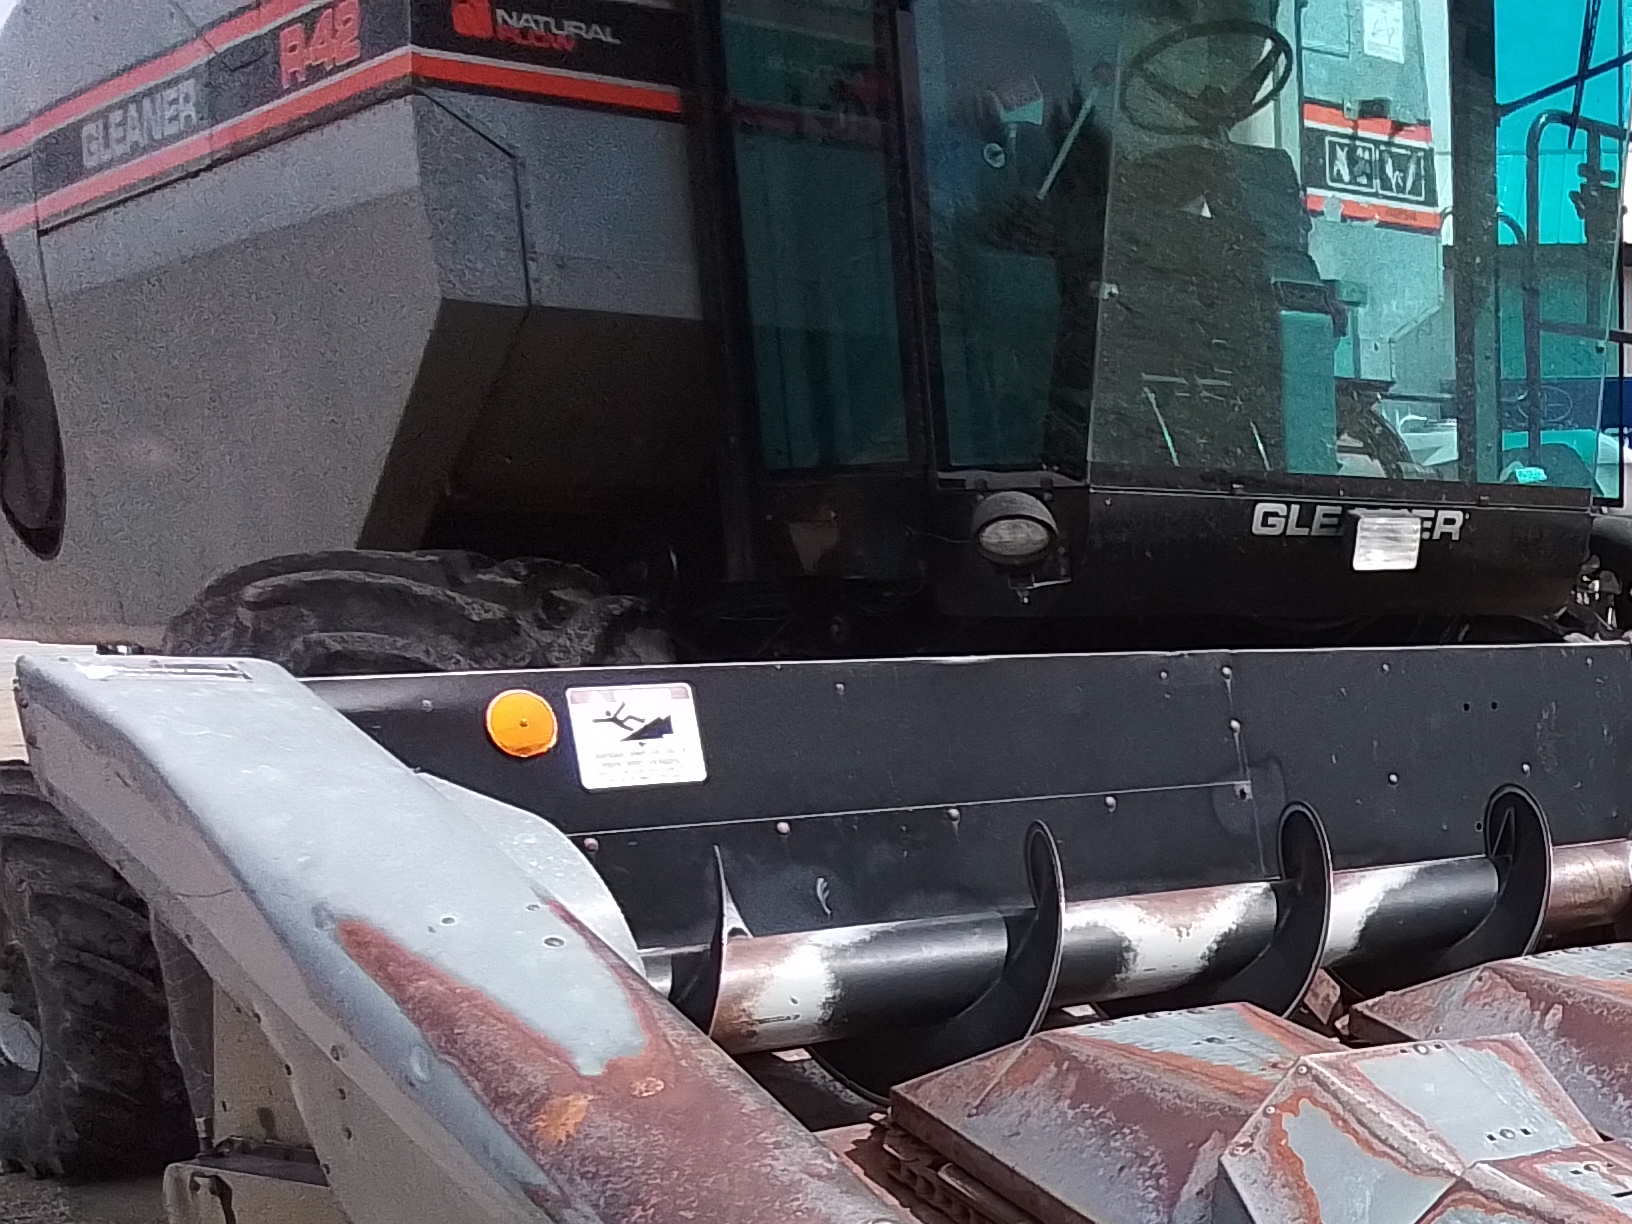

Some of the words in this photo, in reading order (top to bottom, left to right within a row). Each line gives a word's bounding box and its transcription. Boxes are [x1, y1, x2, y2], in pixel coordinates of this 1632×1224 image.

[495, 8, 621, 45] NATURAL
[81, 78, 197, 169] GLEANER
[1251, 502, 1464, 541] GLEER
